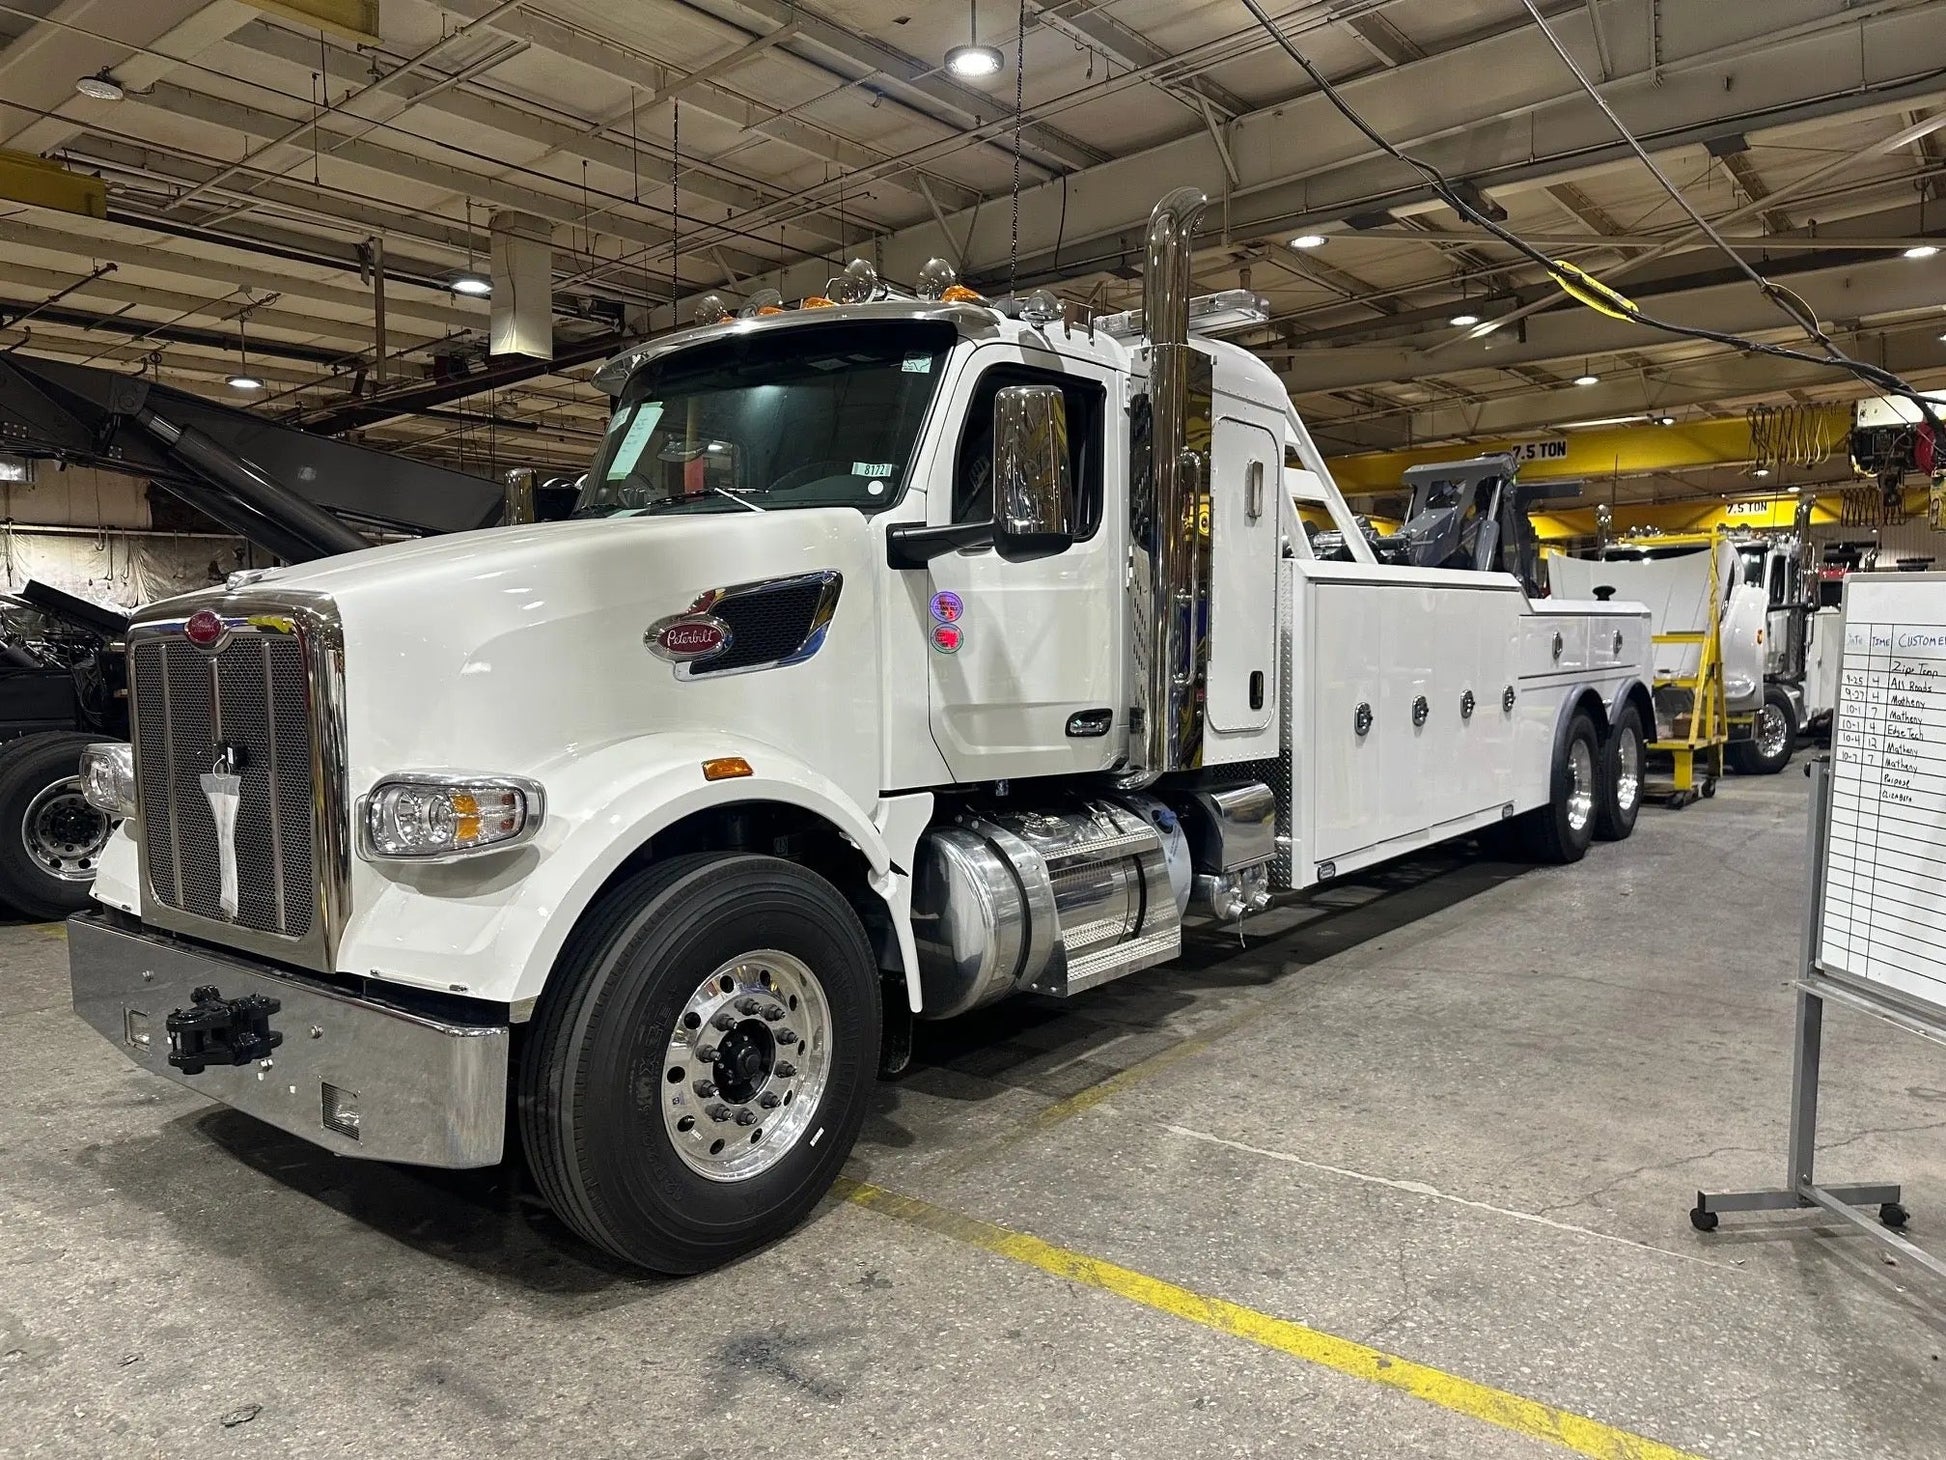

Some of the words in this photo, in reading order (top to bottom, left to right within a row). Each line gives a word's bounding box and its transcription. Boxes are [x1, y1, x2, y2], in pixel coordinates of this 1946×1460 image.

[1512, 443, 1536, 460] 7.5
[1539, 441, 1567, 458] TON
[864, 464, 885, 475] 8172
[1726, 502, 1744, 514] 7.5
[1748, 501, 1767, 512] TON
[667, 629, 717, 647] Peterbilt
[1898, 632, 1946, 648] CUSTOME
[1872, 675, 1880, 688] 4
[1872, 690, 1880, 703] 4
[1871, 706, 1878, 719] 7
[1869, 722, 1876, 734] 4
[1868, 737, 1877, 749] 12
